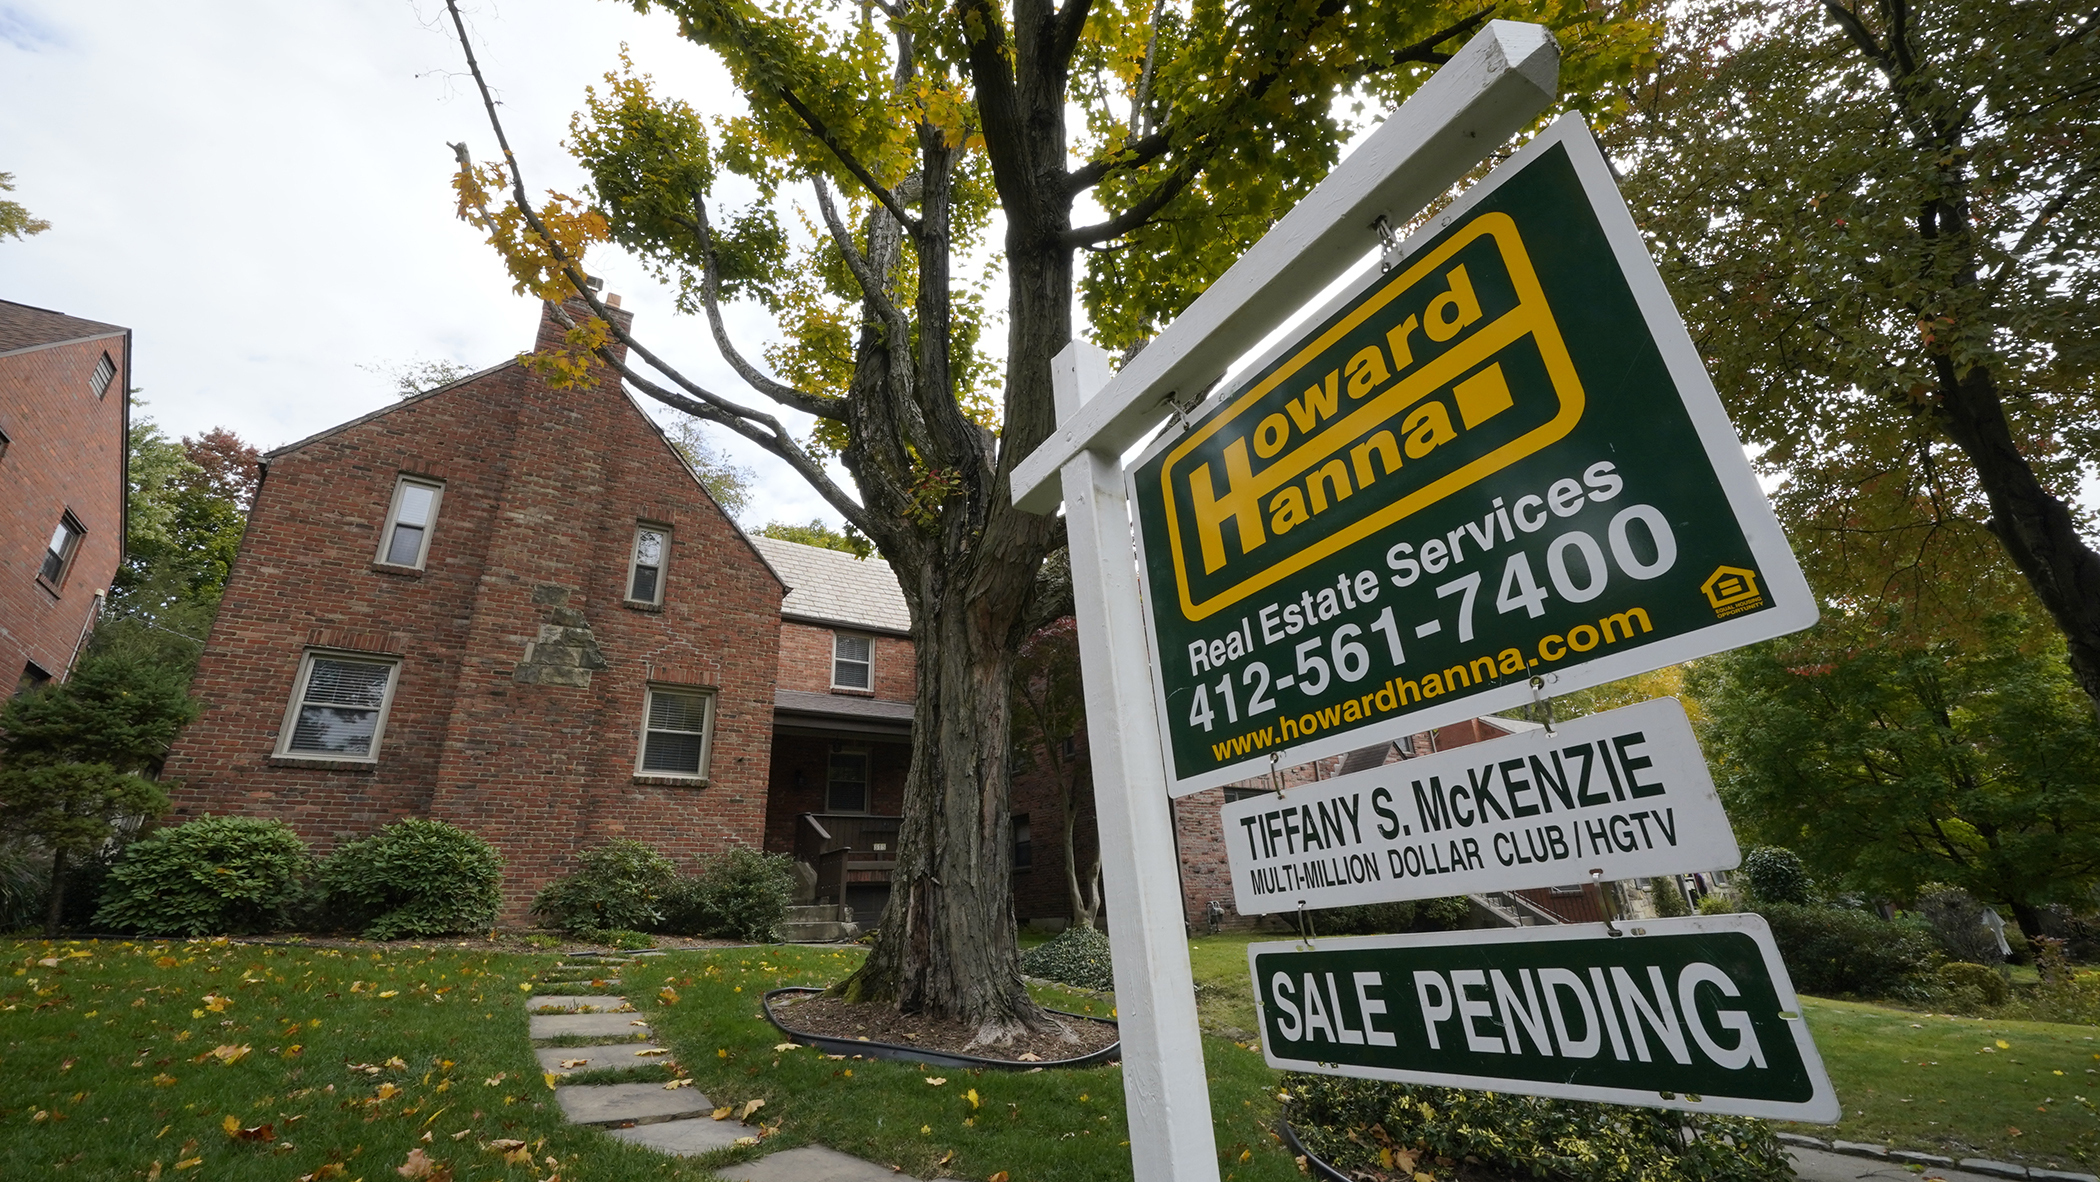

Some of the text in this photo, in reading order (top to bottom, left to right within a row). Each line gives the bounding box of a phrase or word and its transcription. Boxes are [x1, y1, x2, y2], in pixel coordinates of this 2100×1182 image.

[1188, 263, 1484, 512] Howard
[1188, 399, 1458, 576] Hanna
[1188, 459, 1625, 677] Real Estate Services
[1188, 503, 1678, 733] 412-561-7400
[1715, 596, 1762, 614] EQUAL HOUSING
[1717, 601, 1764, 618] OPPORTUNITY
[1211, 605, 1654, 763] www.howardhanna.com
[1240, 731, 1666, 861] TIFFANY S. McKENZIE
[1250, 851, 1382, 897] MULTI-MILLION
[1388, 837, 1485, 880] DOLLAR
[1271, 961, 1769, 1071] SALE PENDING
